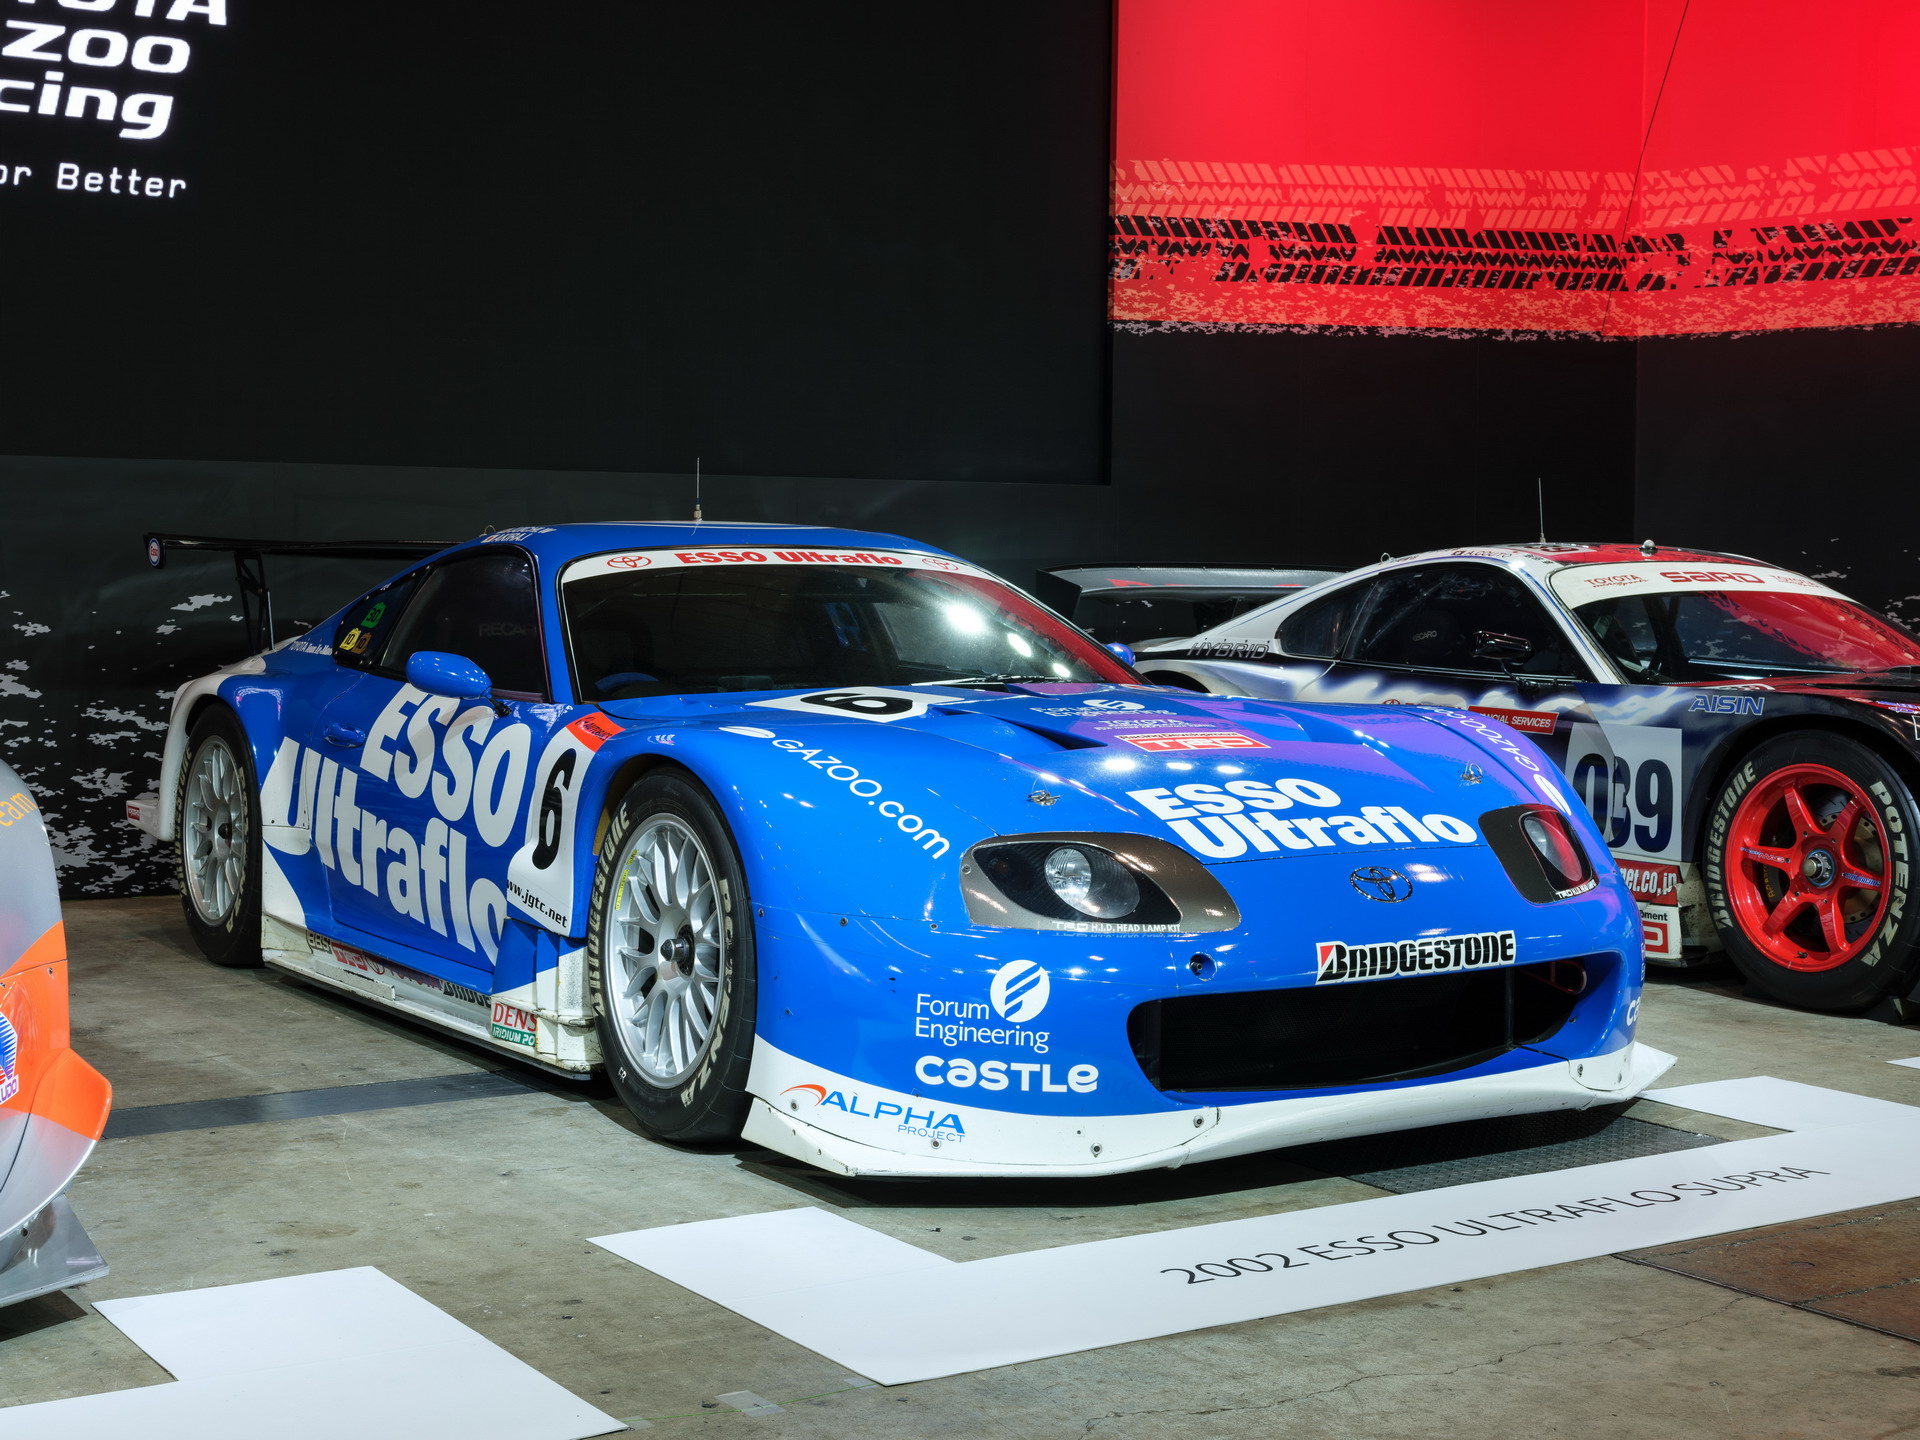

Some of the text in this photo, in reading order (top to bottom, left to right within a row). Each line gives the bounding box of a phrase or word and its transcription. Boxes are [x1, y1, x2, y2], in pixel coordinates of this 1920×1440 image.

[57, 163, 186, 198] Better
[674, 551, 903, 565] ESSO Ultraflo
[1584, 575, 1642, 585] TOYOTA
[366, 608, 381, 622] 30
[345, 634, 355, 645] 10
[1187, 641, 1270, 660] HYBRID
[1511, 715, 1551, 728] SERVICES
[1688, 694, 1765, 715] AISIN
[360, 684, 531, 847] ESSO
[532, 748, 577, 870] 6
[772, 739, 950, 859] GAZOO.com
[1126, 777, 1342, 820] ESSO
[1166, 805, 1478, 858] Ultraflo
[1861, 781, 1909, 967] POTENZA
[1091, 923, 1115, 932] H.I.D.
[1116, 923, 1140, 932] HEAD
[1142, 924, 1167, 932] LAMP
[1167, 924, 1180, 932] KIT
[1317, 932, 1515, 983] BRIDGESTONE
[916, 993, 990, 1020] Forum
[915, 1016, 1050, 1054] Engineering
[819, 1089, 966, 1136] ALPHA
[897, 1123, 966, 1143] PROJECT
[1160, 1166, 1831, 1285] 2002 ESSO ULTRAFLO SUPRA
